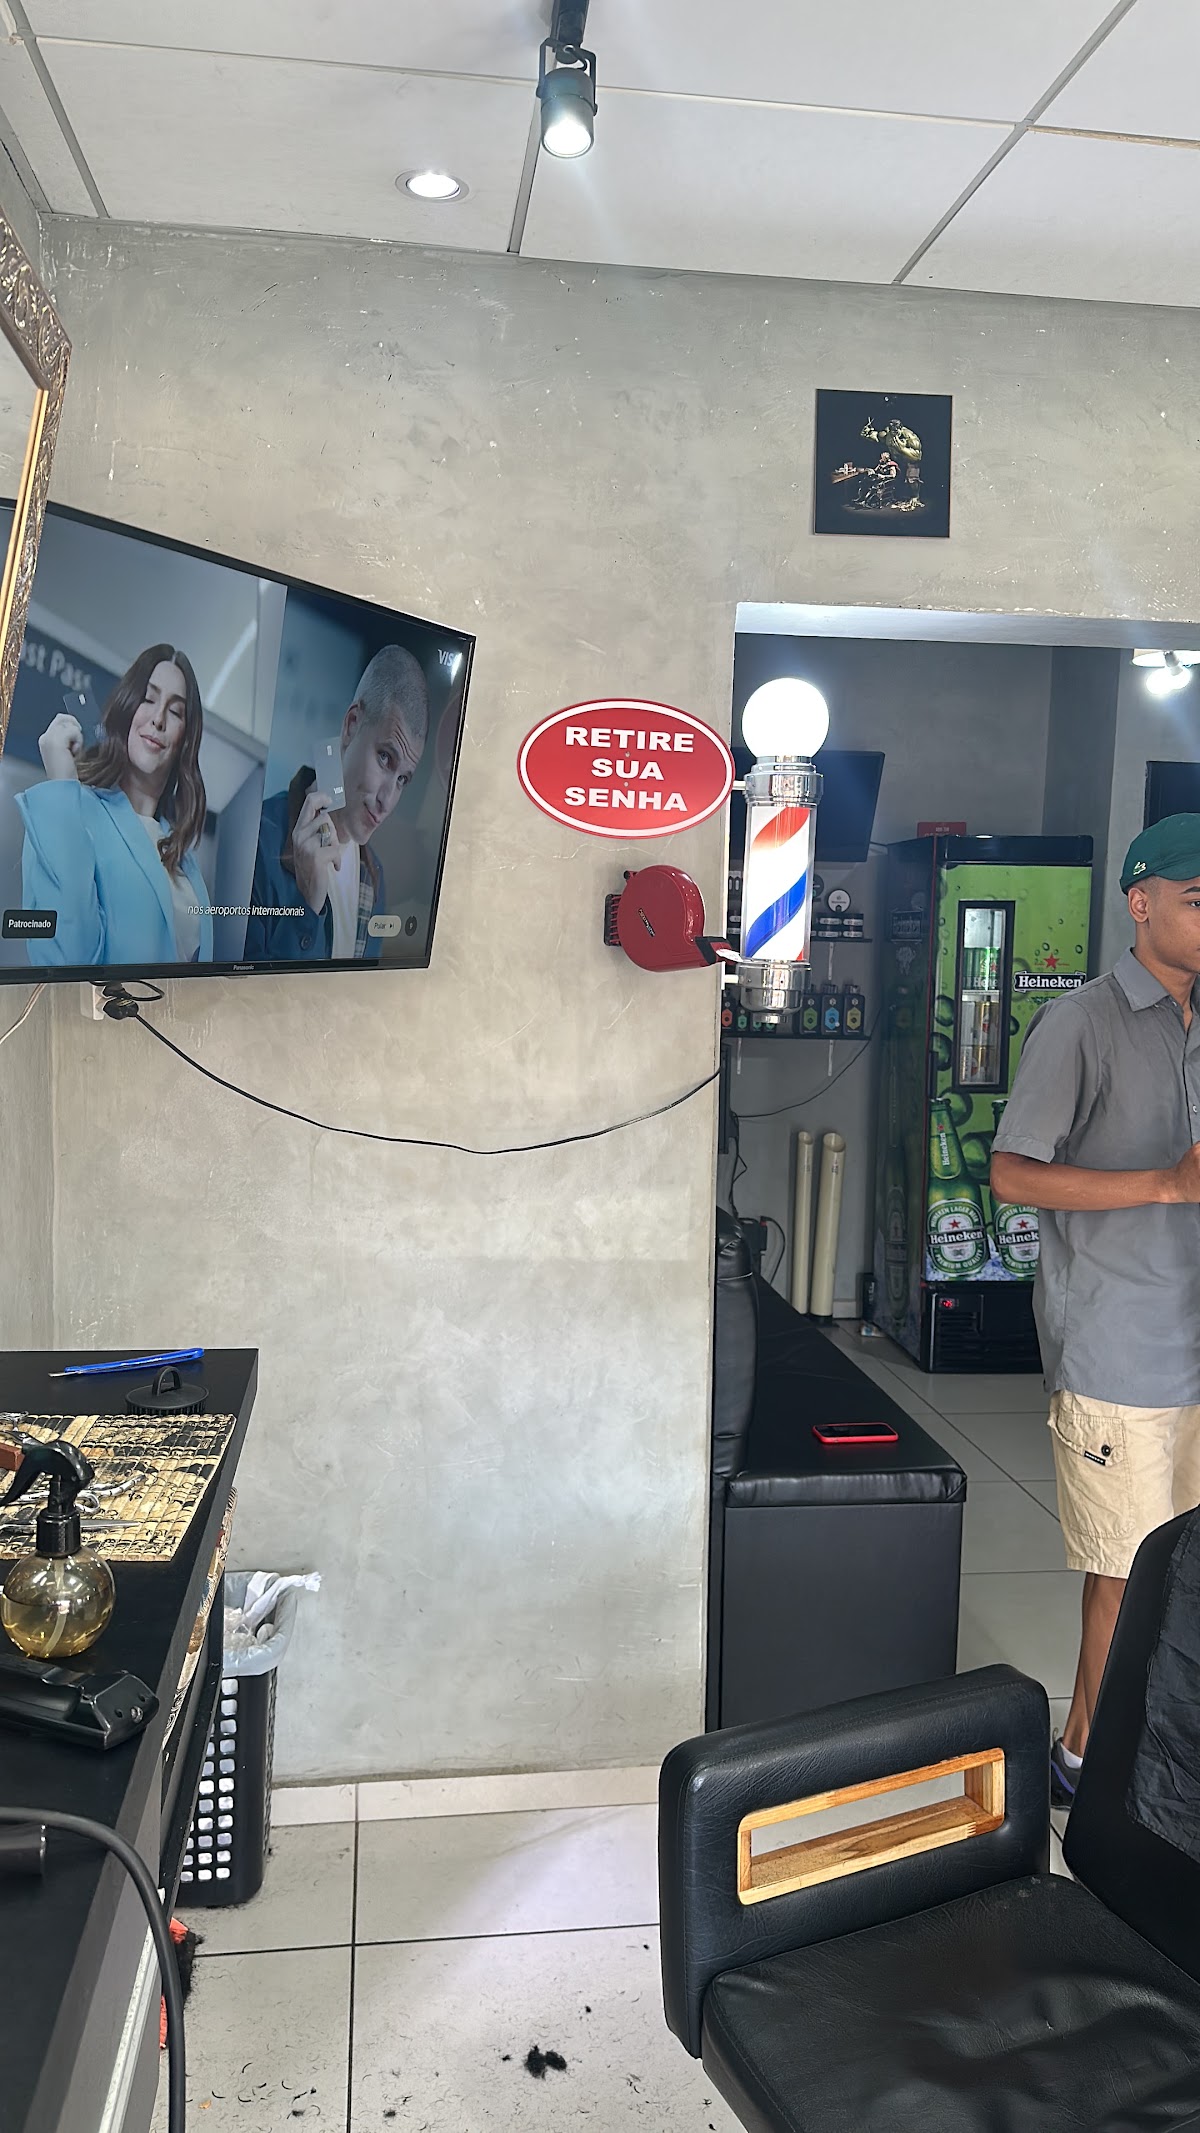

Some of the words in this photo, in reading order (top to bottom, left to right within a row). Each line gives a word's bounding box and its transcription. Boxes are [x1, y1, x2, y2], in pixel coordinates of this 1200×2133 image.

[437, 648, 462, 668] VIS
[565, 726, 695, 753] RETIRE
[591, 758, 665, 781] SUA
[564, 786, 688, 812] SENHA
[187, 905, 204, 915] nos
[205, 904, 251, 917] aeroportos
[251, 904, 305, 917] internacionais
[8, 919, 52, 929] Patrocinado
[1018, 975, 1082, 989] Heineken
[940, 1132, 950, 1166] Heineken
[930, 1230, 983, 1244] Heineken
[998, 1231, 1039, 1245] Heinek
